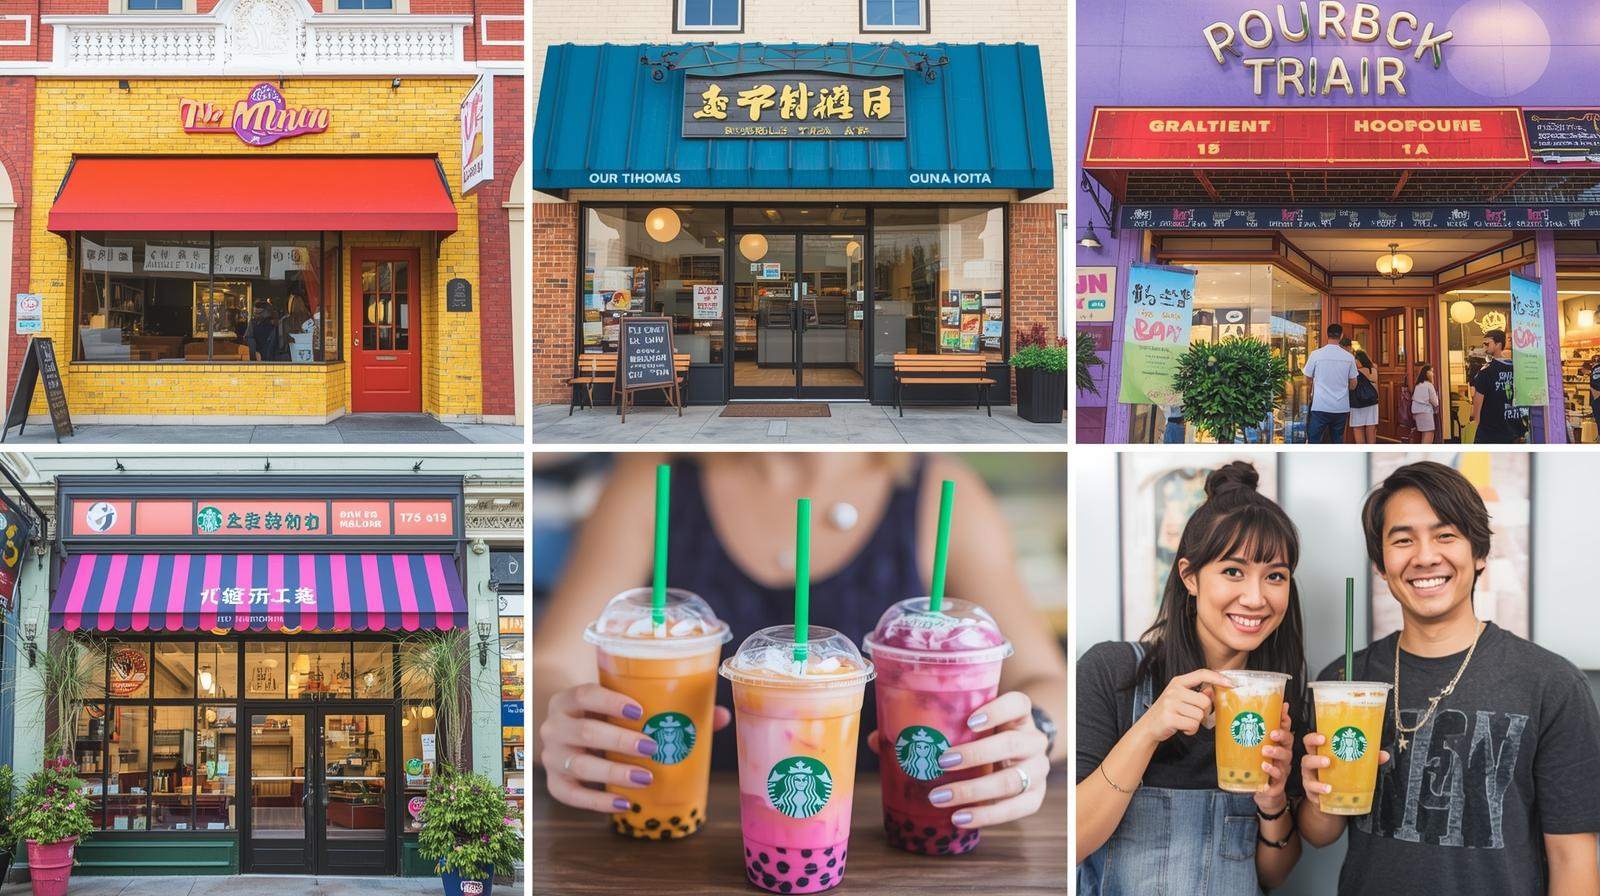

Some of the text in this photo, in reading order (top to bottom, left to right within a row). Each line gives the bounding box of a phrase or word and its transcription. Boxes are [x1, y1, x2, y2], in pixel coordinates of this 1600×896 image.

[1243, 56, 1407, 96] TRIAIR
[1149, 119, 1270, 132] GRALTIENT
[589, 173, 618, 184] OUR
[909, 173, 952, 184] OUNA
